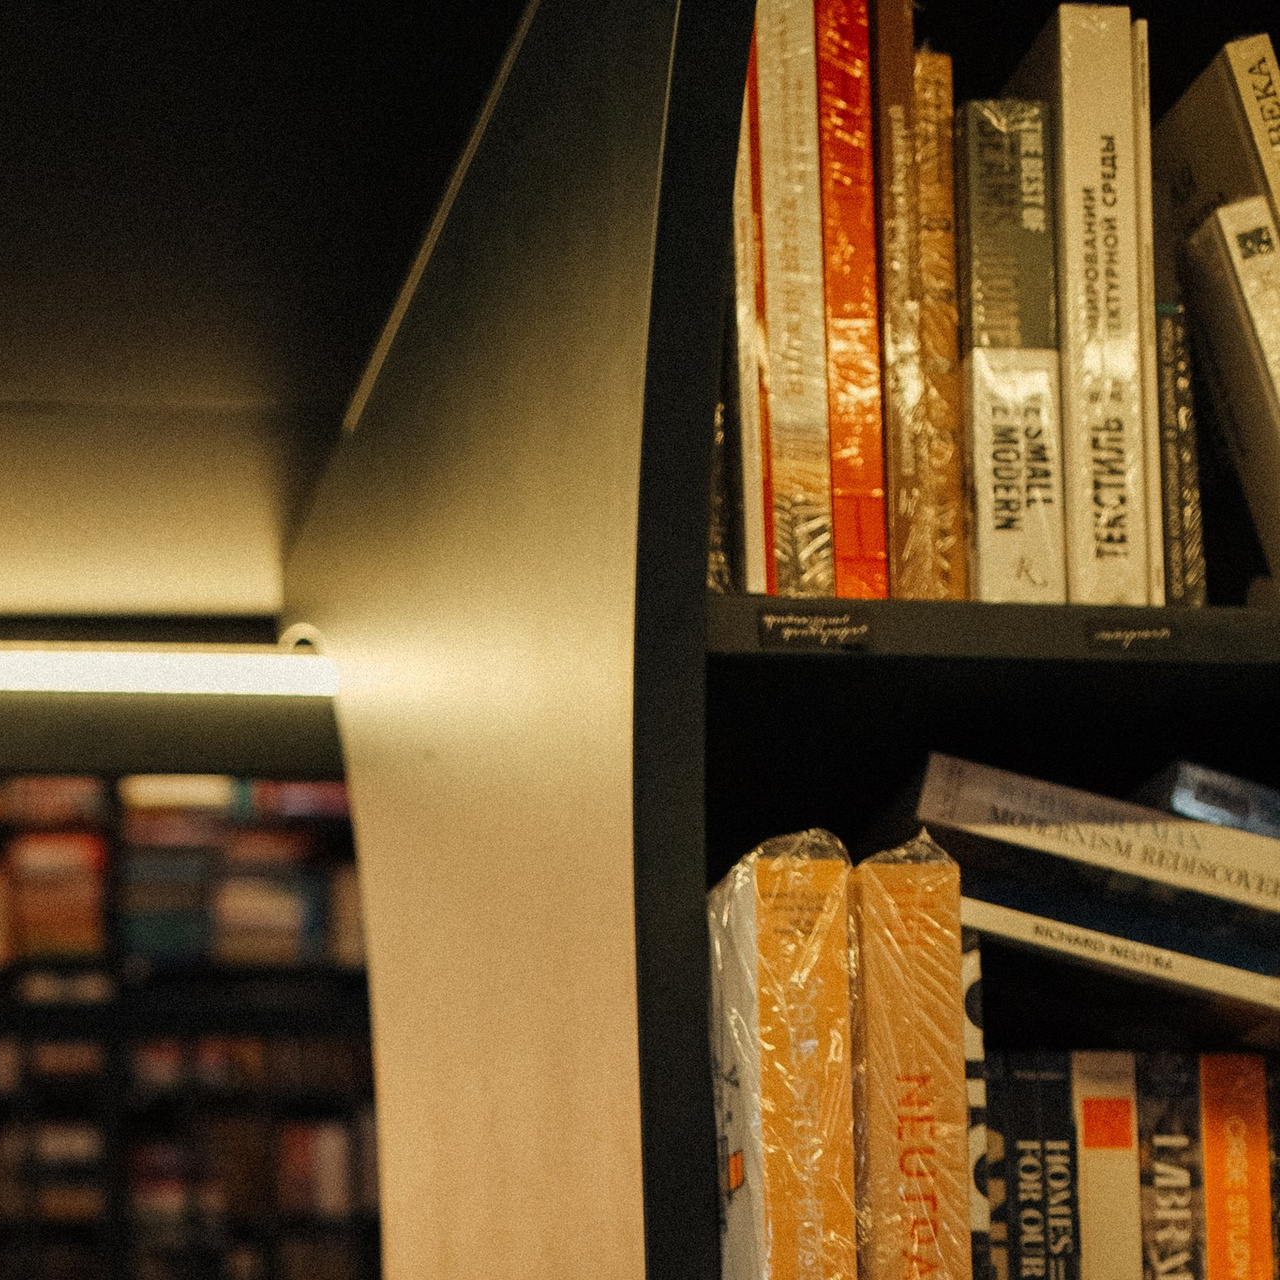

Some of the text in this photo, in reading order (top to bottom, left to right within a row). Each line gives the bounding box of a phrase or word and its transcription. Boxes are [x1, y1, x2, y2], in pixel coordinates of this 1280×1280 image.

[1101, 134, 1118, 209] СРЕДЫ
[992, 424, 1023, 531] MODERN
[1090, 415, 1129, 559] ТЕКСТИЛЬ
[1140, 844, 1280, 899] REDISCOVE
[1015, 1139, 1043, 1203] FOR
[1044, 1139, 1073, 1256] HOMES
[1020, 1208, 1047, 1279] OUR
[1226, 1193, 1252, 1280] STUDY
